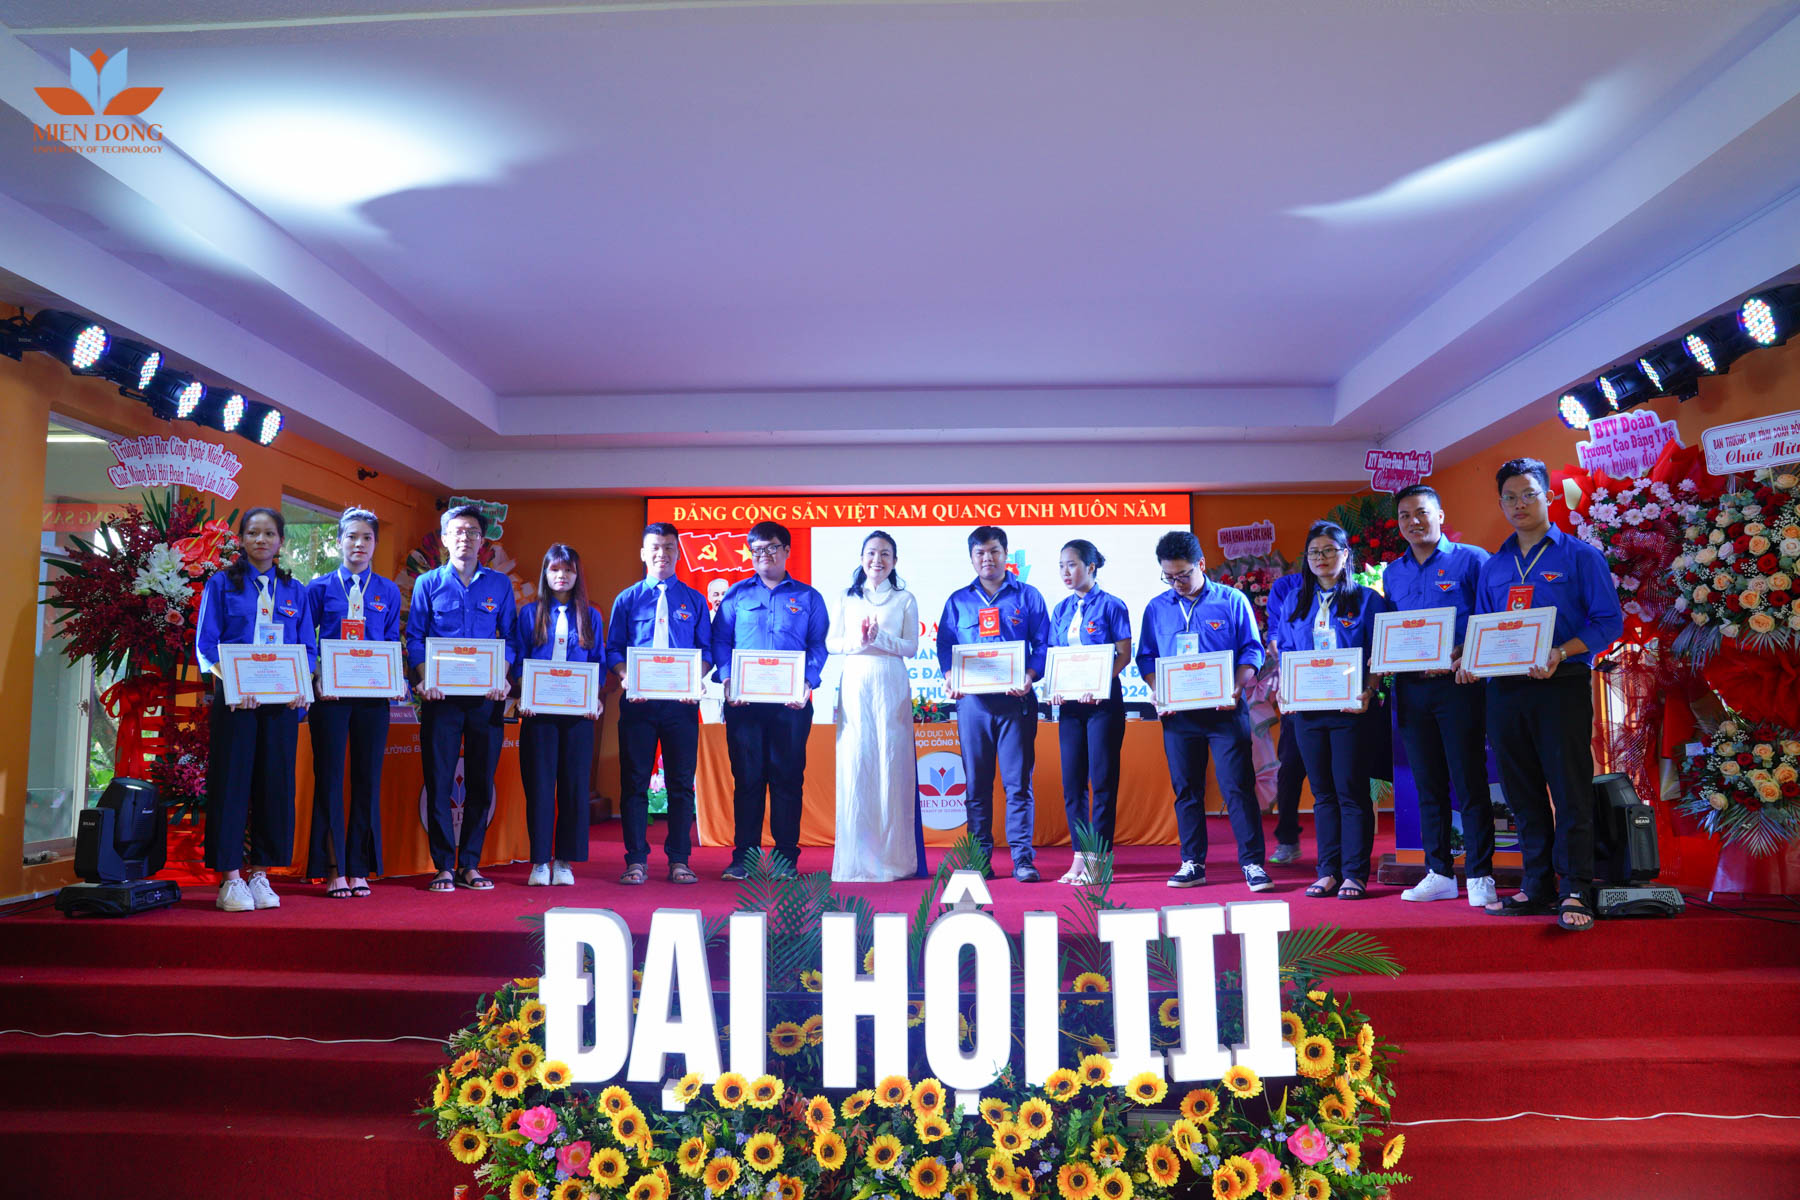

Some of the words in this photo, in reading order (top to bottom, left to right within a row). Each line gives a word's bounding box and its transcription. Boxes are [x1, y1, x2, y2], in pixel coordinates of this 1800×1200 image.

[1593, 418, 1617, 439] BTV
[1613, 438, 1630, 452] Cao
[1655, 428, 1661, 443] Y
[1726, 449, 1763, 465] Chúc
[673, 502, 727, 521] ĐẢNG
[732, 503, 787, 524] CỘNG
[791, 501, 828, 520] SẢN
[834, 502, 878, 523] VIỆT
[883, 504, 927, 519] NAM
[932, 503, 1001, 521] QUANG
[1006, 503, 1054, 518] VINH
[1060, 499, 1117, 518] MUÔN
[1124, 499, 1167, 517] NĂM
[538, 907, 767, 1112] ĐẠI
[822, 869, 1060, 1116] HỘI
[1097, 900, 1297, 1087] III
